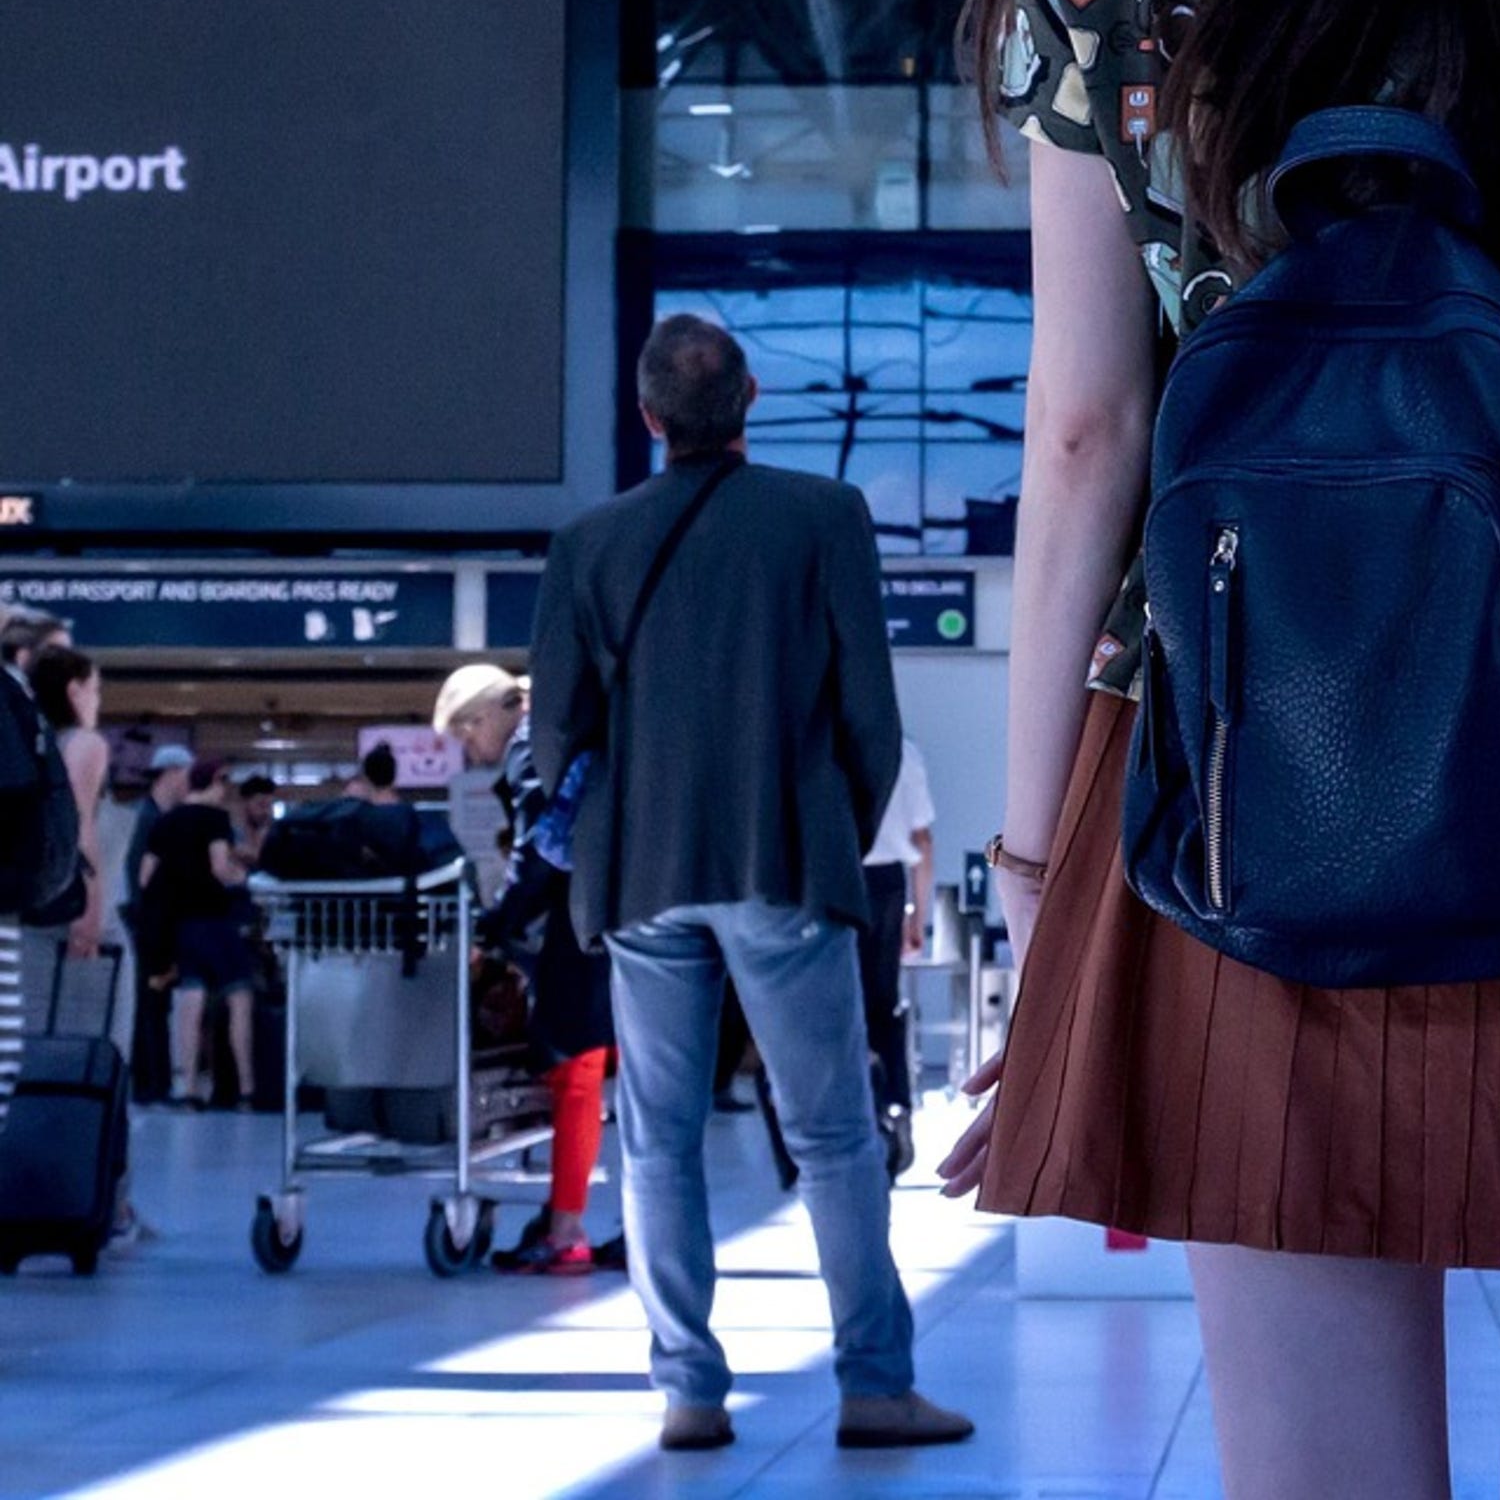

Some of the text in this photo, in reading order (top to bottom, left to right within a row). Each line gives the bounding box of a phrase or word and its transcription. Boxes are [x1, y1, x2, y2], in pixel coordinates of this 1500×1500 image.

[0, 143, 187, 201] Airport
[18, 580, 66, 601] YOUR
[68, 580, 157, 602] PASSPORT
[159, 580, 198, 601] AND
[201, 580, 289, 602] BOARDING
[292, 580, 336, 602] PASS
[338, 580, 398, 602] READY
